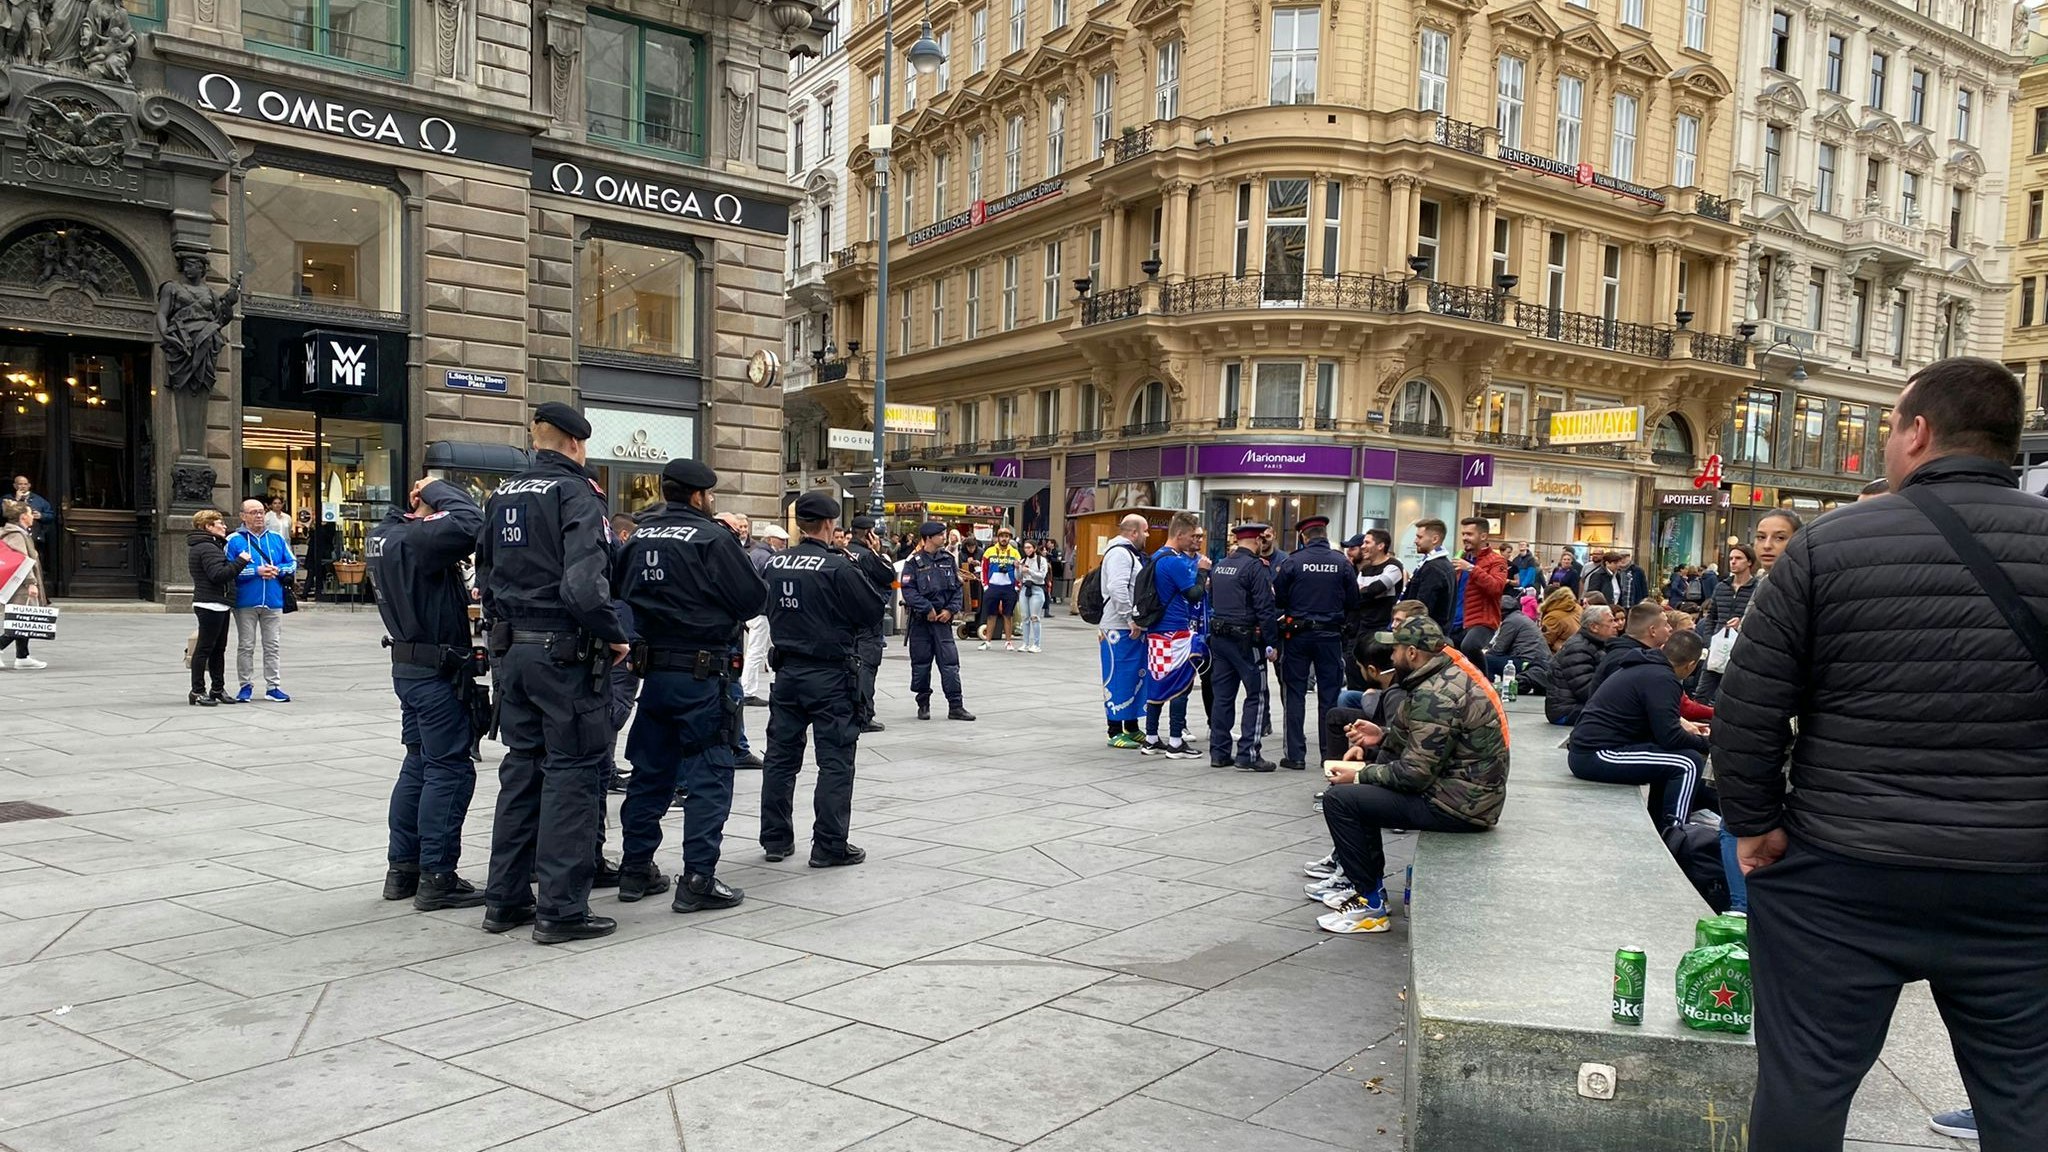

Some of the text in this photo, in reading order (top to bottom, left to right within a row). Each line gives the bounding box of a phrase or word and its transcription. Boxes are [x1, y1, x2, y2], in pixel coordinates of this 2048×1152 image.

[257, 90, 405, 144] OMEGA
[11, 153, 139, 192] EQUITABLE
[594, 175, 704, 218] OMEGA
[1555, 410, 1633, 438] STURMAYR
[832, 434, 874, 446] BIOGEN
[612, 443, 670, 460] OMEGA
[1240, 450, 1306, 466] Marionnaud
[941, 475, 1018, 489] WIENER WÜRSTL
[1530, 475, 1582, 497] Läderach
[1663, 493, 1713, 505] APOTHEKE
[505, 508, 517, 524] U
[501, 526, 522, 542] 130
[645, 550, 659, 567] U
[764, 554, 826, 571] POLIZEI
[641, 568, 665, 581] 130
[1214, 566, 1238, 575] POLIZEI
[1302, 563, 1338, 573] POLIZEI
[782, 581, 794, 596] U
[13, 606, 54, 615] HUMANIC
[779, 597, 799, 609] 130
[11, 622, 53, 631] HUMANIC
[1616, 957, 1643, 992] RIGINAL
